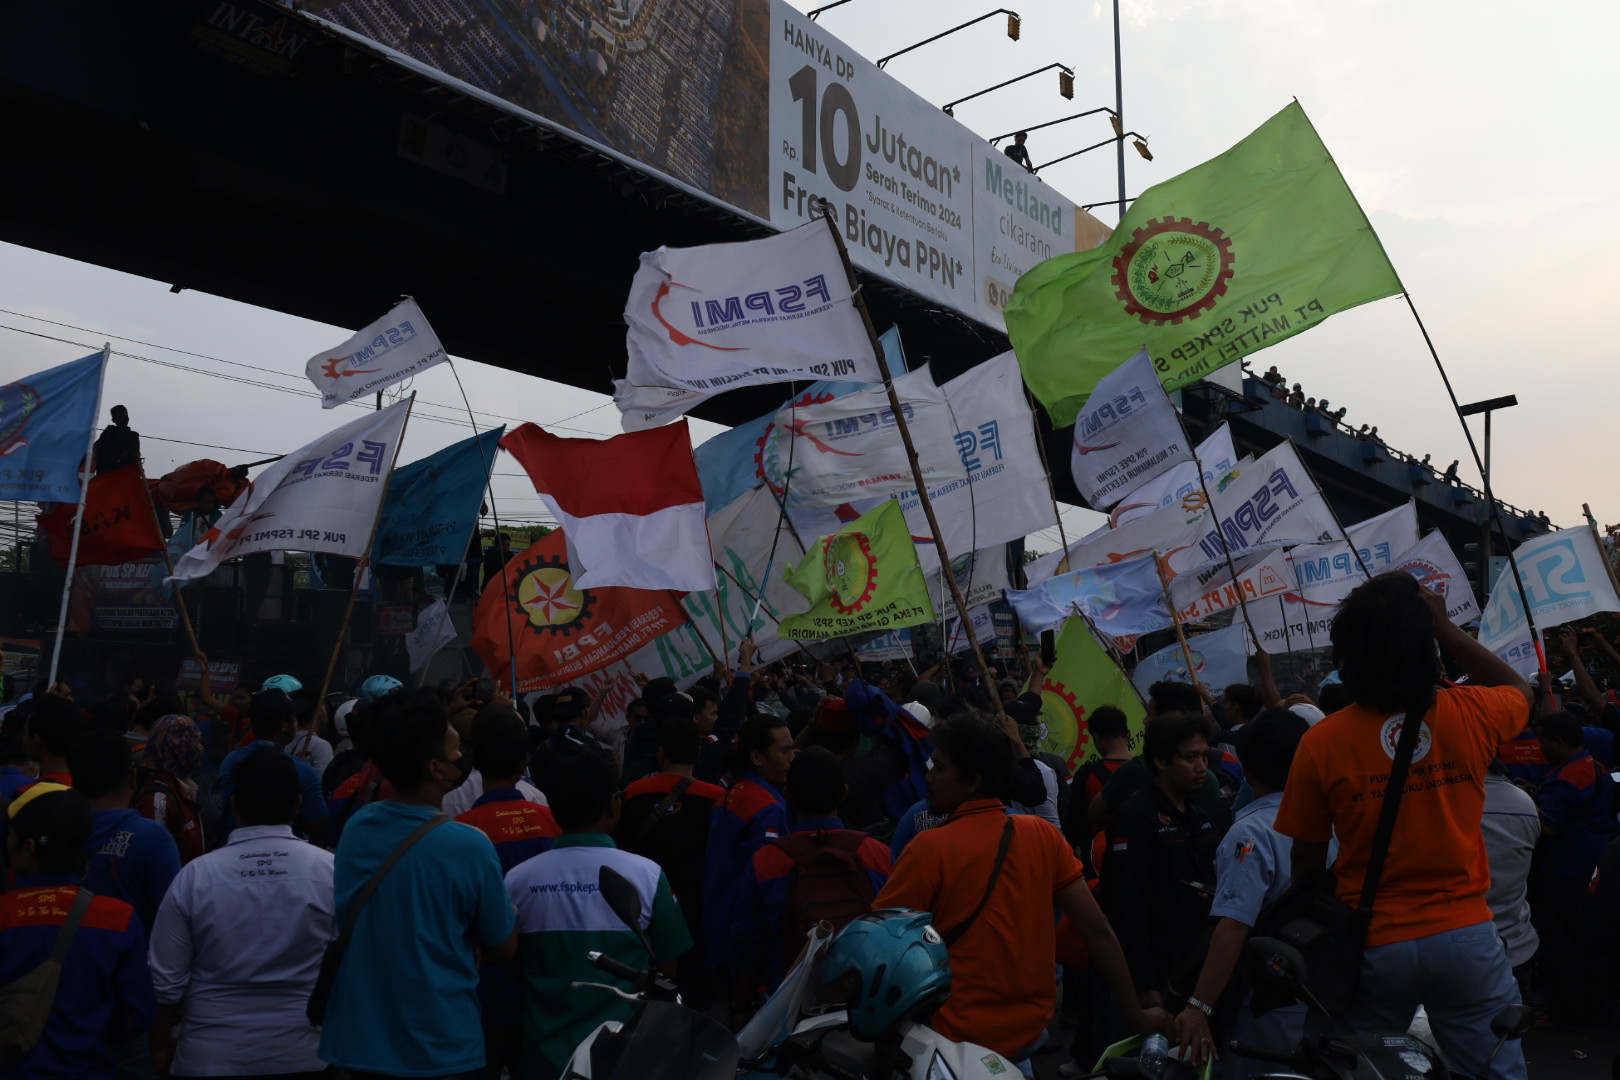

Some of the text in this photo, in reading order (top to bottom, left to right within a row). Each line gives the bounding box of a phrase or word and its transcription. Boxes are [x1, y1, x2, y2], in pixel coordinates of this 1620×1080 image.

[206, 0, 308, 60] INTAN
[785, 19, 855, 82] HANYA DP
[782, 139, 799, 160] Rp.
[788, 64, 862, 192] 10
[866, 162, 962, 231] Serah Terima 2024
[986, 156, 1062, 236] Metland
[846, 203, 911, 268] Biaya
[1425, 774, 1474, 790] INDONESIA
[1428, 760, 1456, 774] FSPMI
